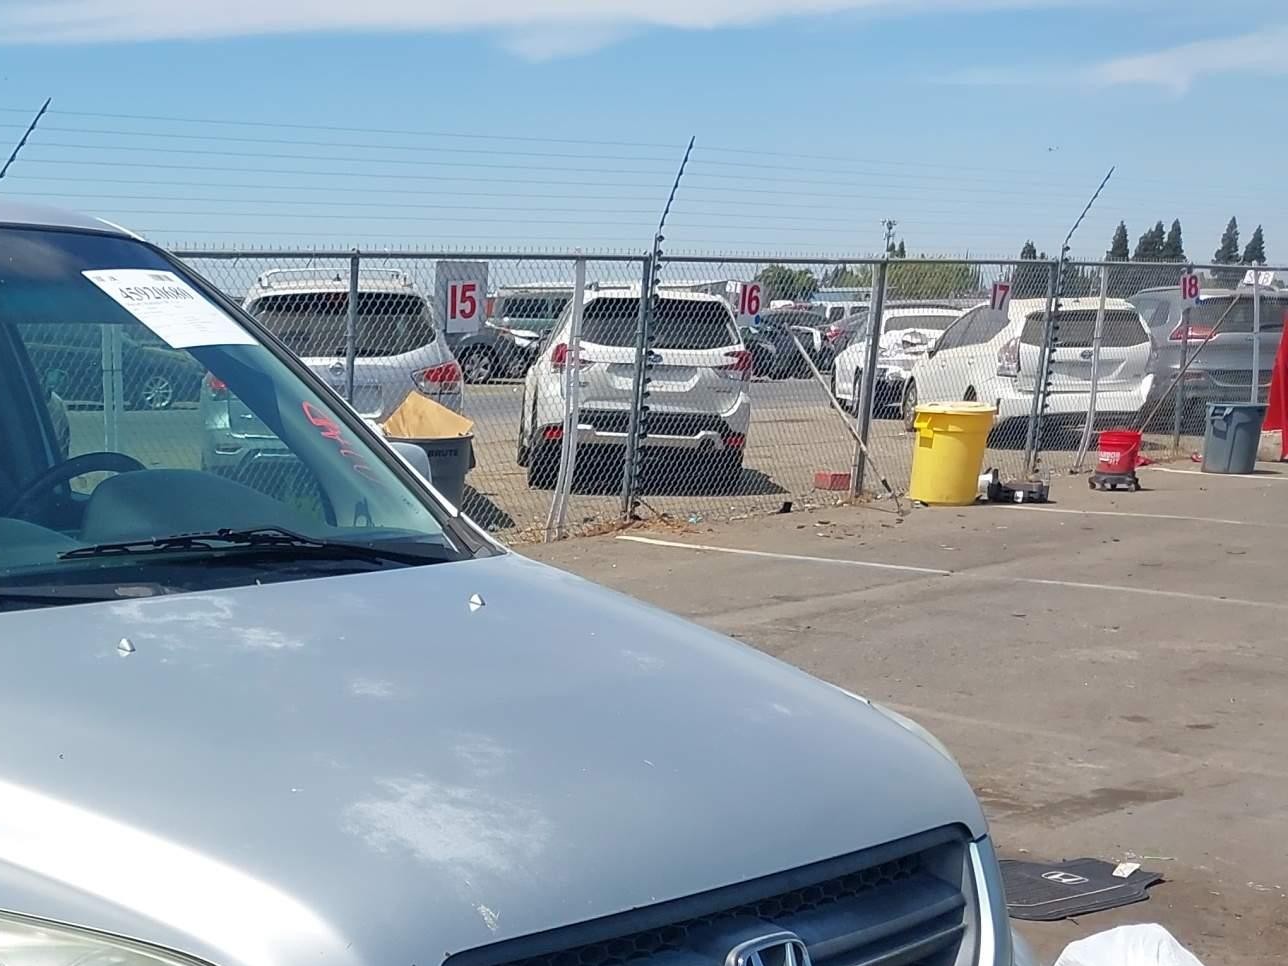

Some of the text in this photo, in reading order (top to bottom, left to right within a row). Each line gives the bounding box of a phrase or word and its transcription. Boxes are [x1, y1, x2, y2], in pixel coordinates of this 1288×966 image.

[450, 283, 476, 319] 15
[740, 284, 761, 316] 16
[992, 283, 1010, 310] 17
[1182, 275, 1199, 299] 18
